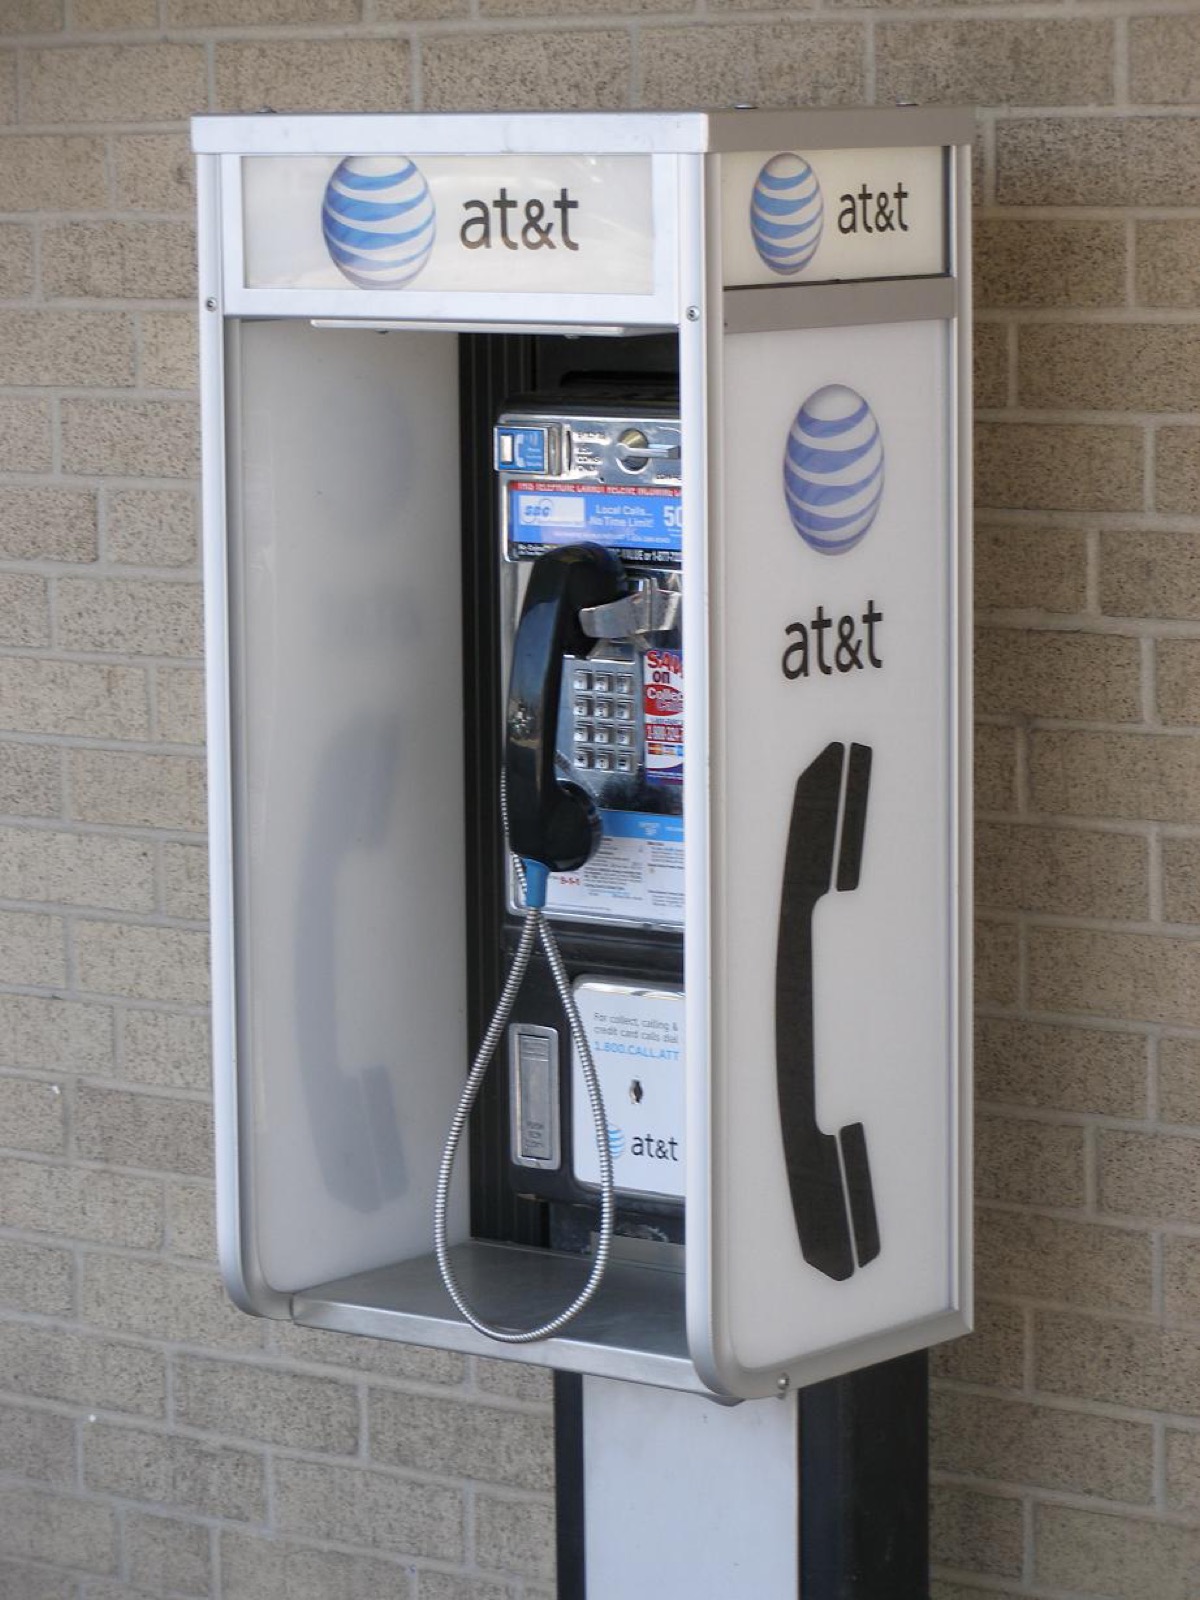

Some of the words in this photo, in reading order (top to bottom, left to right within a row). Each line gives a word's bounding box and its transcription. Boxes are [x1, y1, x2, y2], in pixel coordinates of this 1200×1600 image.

[837, 182, 909, 234] at&t
[460, 188, 580, 251] at&t
[596, 504, 620, 514] Local
[603, 516, 626, 527] Time
[781, 600, 883, 680] at&t
[652, 670, 671, 684] on
[594, 1012, 607, 1022] For
[641, 1019, 669, 1032] calling
[672, 1022, 678, 1031] &
[593, 1026, 618, 1036] credit
[620, 1029, 639, 1039] card
[641, 1030, 660, 1042] calls
[662, 1033, 678, 1044] dial
[631, 1134, 678, 1161] at&t
